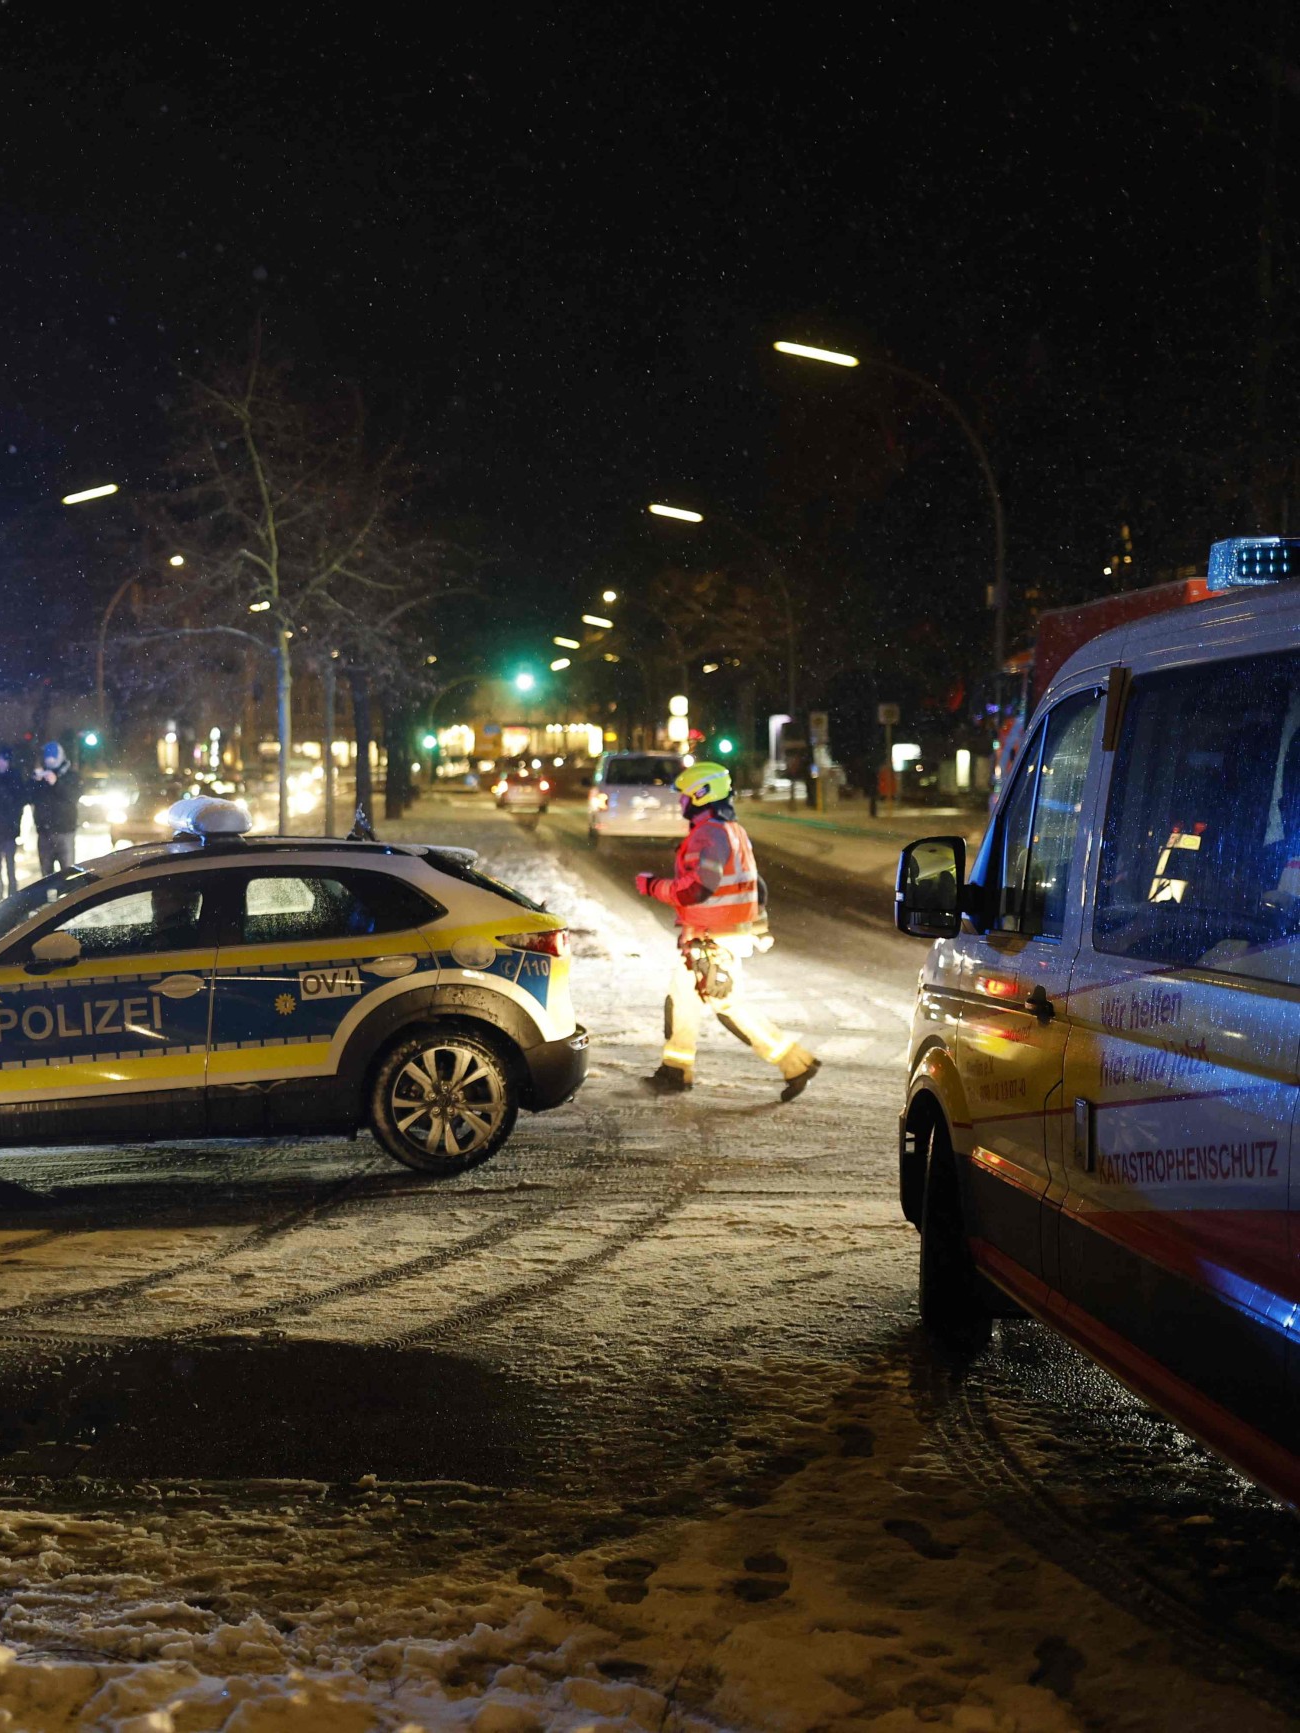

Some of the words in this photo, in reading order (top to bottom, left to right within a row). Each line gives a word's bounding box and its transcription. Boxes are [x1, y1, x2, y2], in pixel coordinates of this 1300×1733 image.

[302, 972, 338, 995] OV
[344, 969, 357, 992] 4
[523, 959, 549, 977] 110
[1101, 998, 1126, 1034] Wir
[1130, 987, 1182, 1030] helfen
[1100, 1051, 1131, 1087] hier
[1133, 1041, 1168, 1083] und
[1098, 1141, 1278, 1185] KATASTROPHENSCHUTZ
